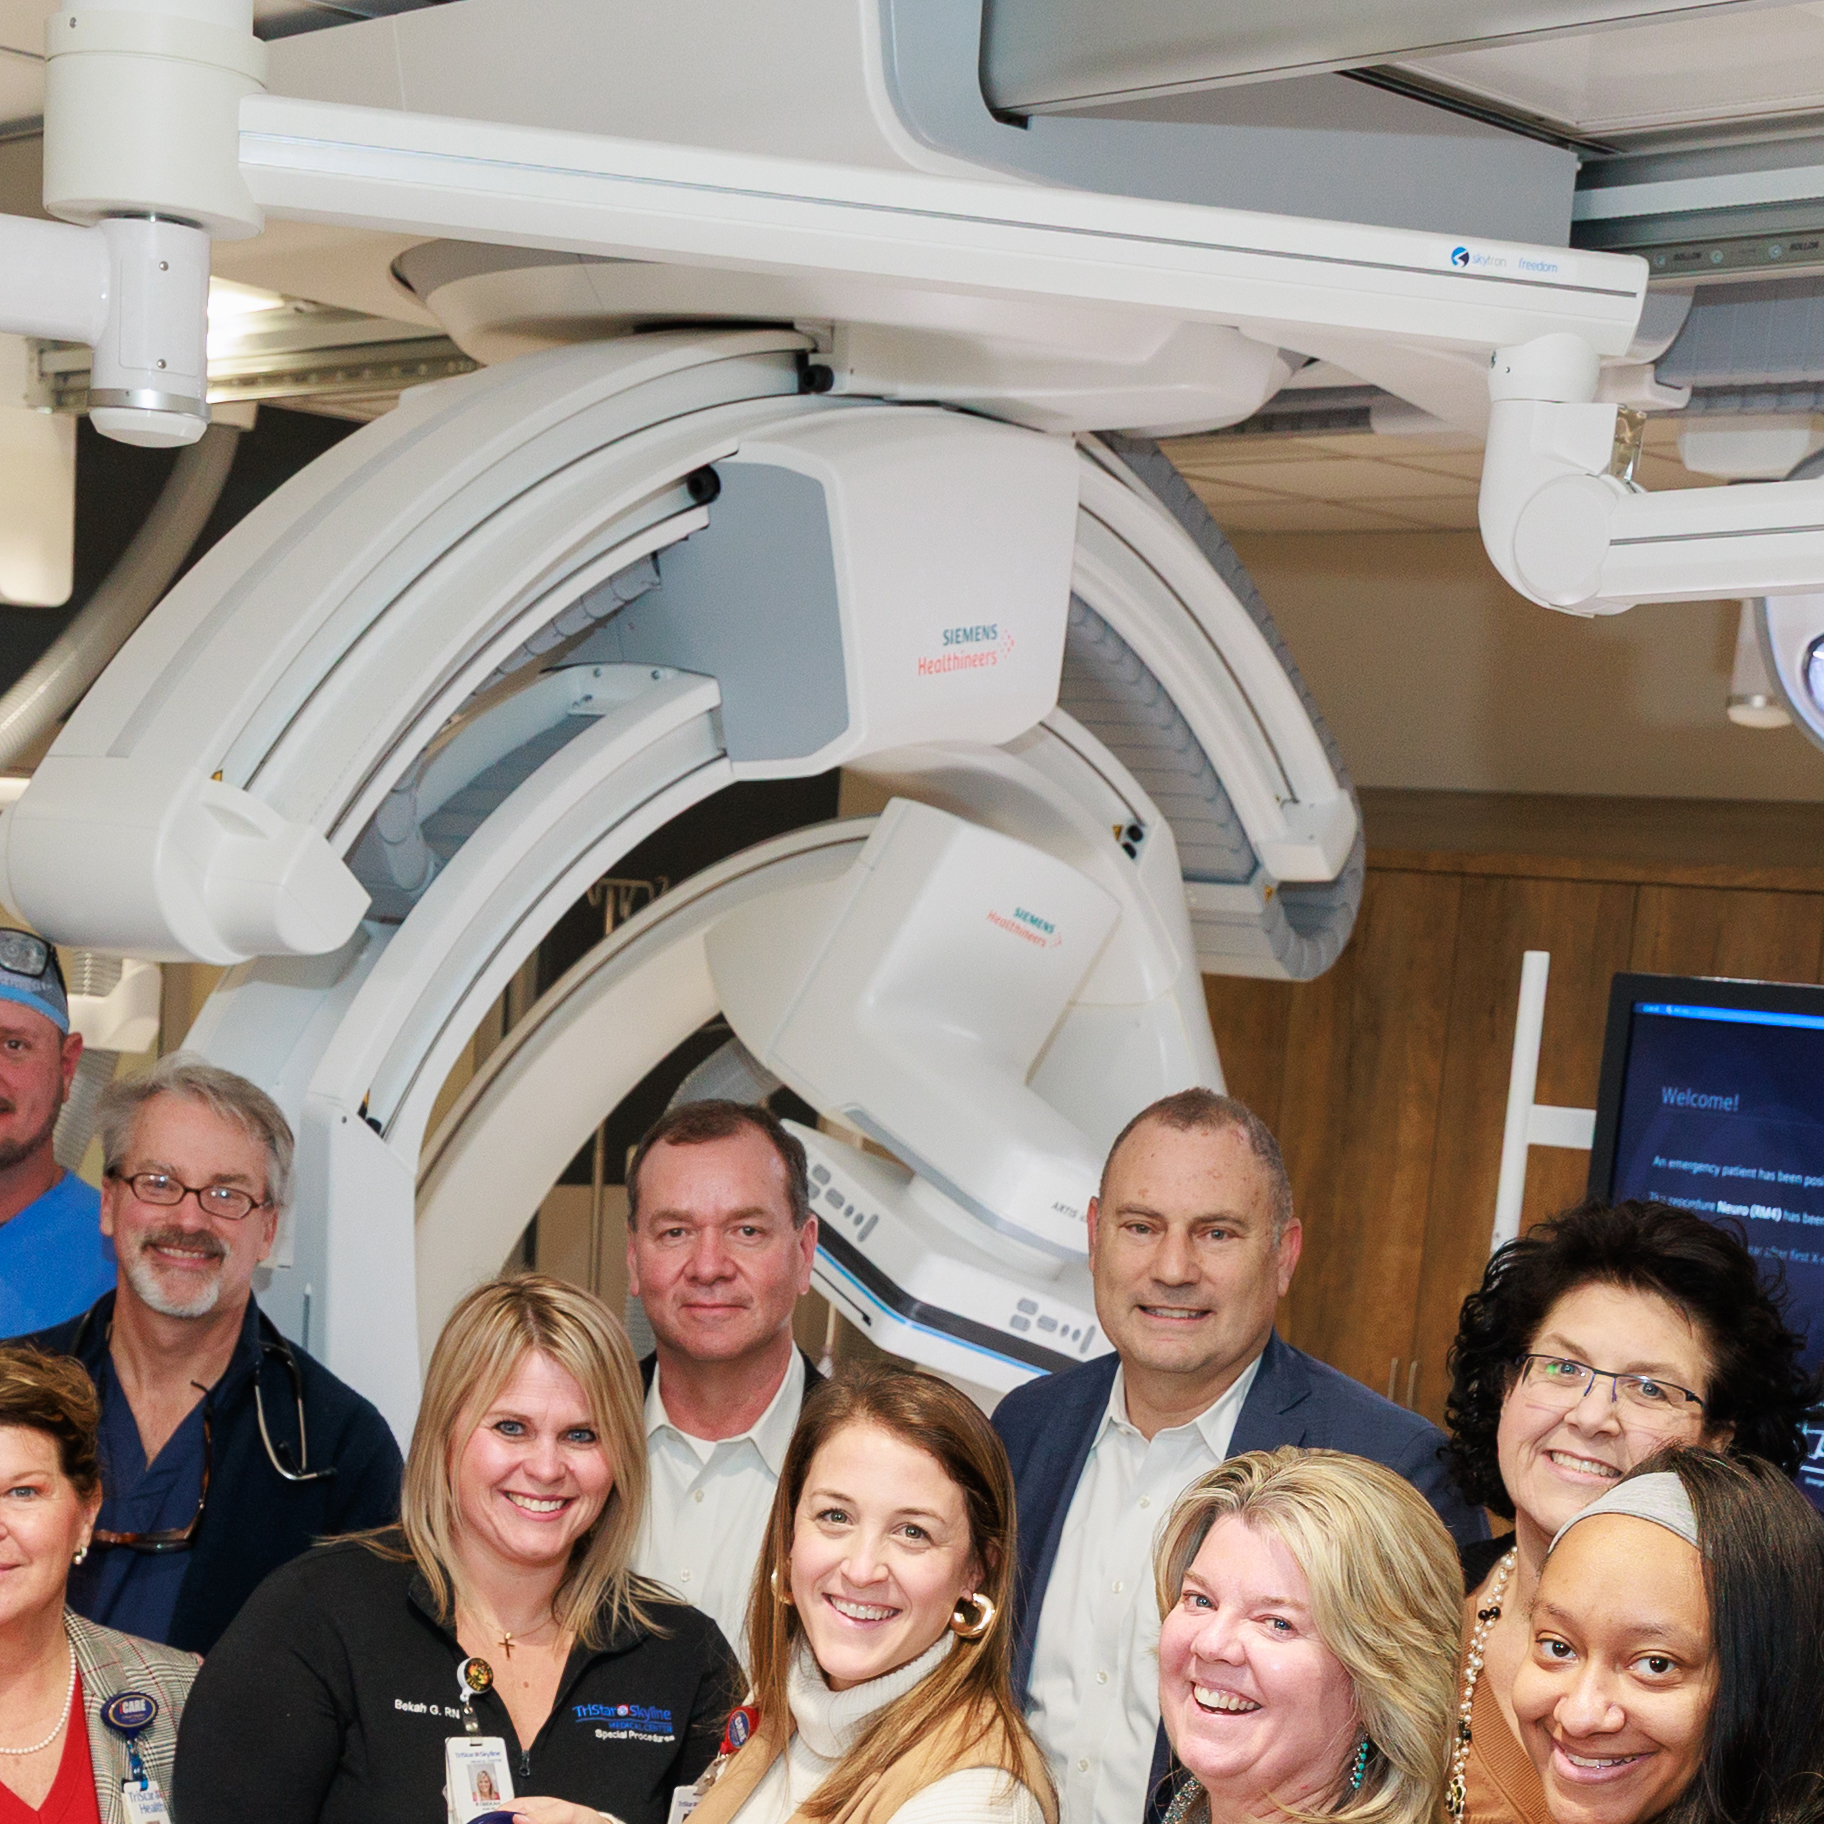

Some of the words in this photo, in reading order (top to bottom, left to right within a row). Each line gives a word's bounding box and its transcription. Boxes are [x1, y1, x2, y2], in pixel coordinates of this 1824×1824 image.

[942, 623, 998, 646] SIEMENS
[918, 649, 998, 676] Healthineers
[1013, 906, 1056, 934] SIEMENS
[1661, 1086, 1740, 1112] Welcome!
[1653, 1155, 1667, 1167] An
[1668, 1158, 1721, 1177] emergency
[1721, 1164, 1757, 1179] patient
[1758, 1167, 1776, 1182] has
[1777, 1170, 1803, 1185] been
[1716, 1200, 1750, 1217] Neuro
[1783, 1209, 1801, 1223] has
[394, 1699, 428, 1714] Bekah
[429, 1704, 442, 1717] G.
[444, 1706, 461, 1719] RN
[572, 1703, 616, 1718] TriStar
[629, 1704, 672, 1722] Skyline
[594, 1728, 628, 1740] Special
[628, 1730, 676, 1743] Procedures
